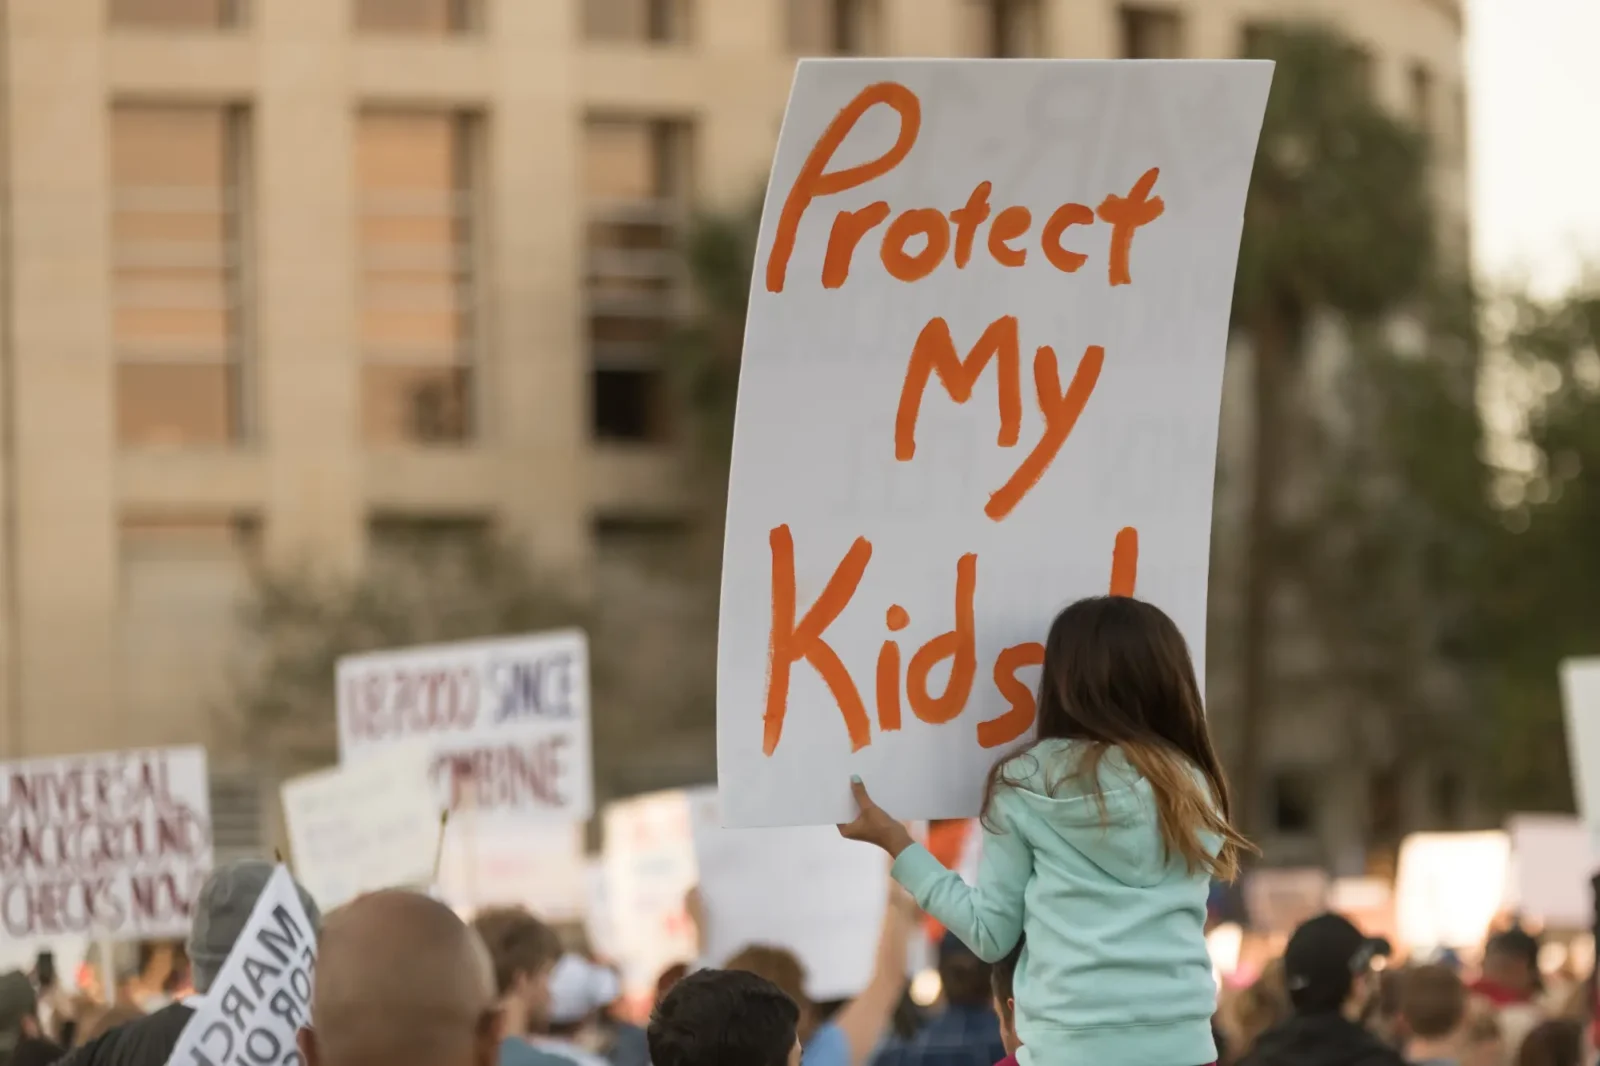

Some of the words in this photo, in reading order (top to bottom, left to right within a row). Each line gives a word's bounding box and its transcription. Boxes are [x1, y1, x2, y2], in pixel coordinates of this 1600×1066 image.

[766, 81, 1165, 293] Protect
[895, 315, 1105, 522] My
[6, 750, 174, 823] NIVERSAL
